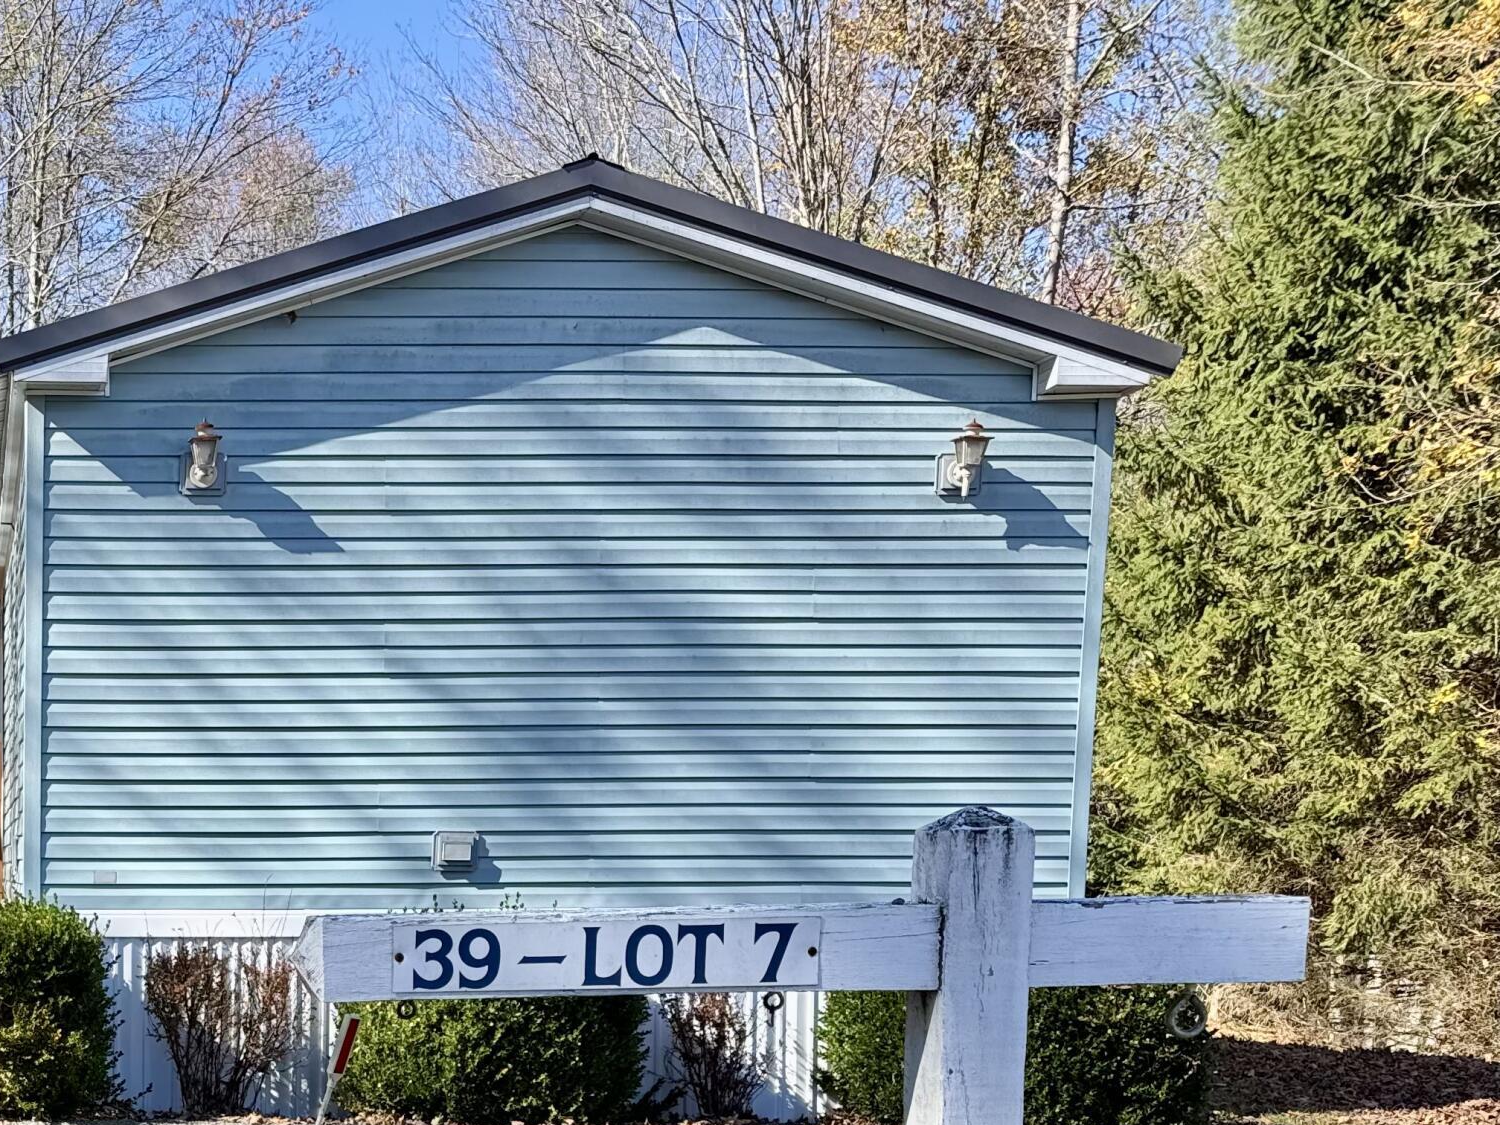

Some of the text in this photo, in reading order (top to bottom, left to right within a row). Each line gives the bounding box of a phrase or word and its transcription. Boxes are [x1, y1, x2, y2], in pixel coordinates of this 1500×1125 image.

[412, 928, 501, 991] 39
[581, 923, 725, 987] LOT
[753, 922, 801, 983] 7
